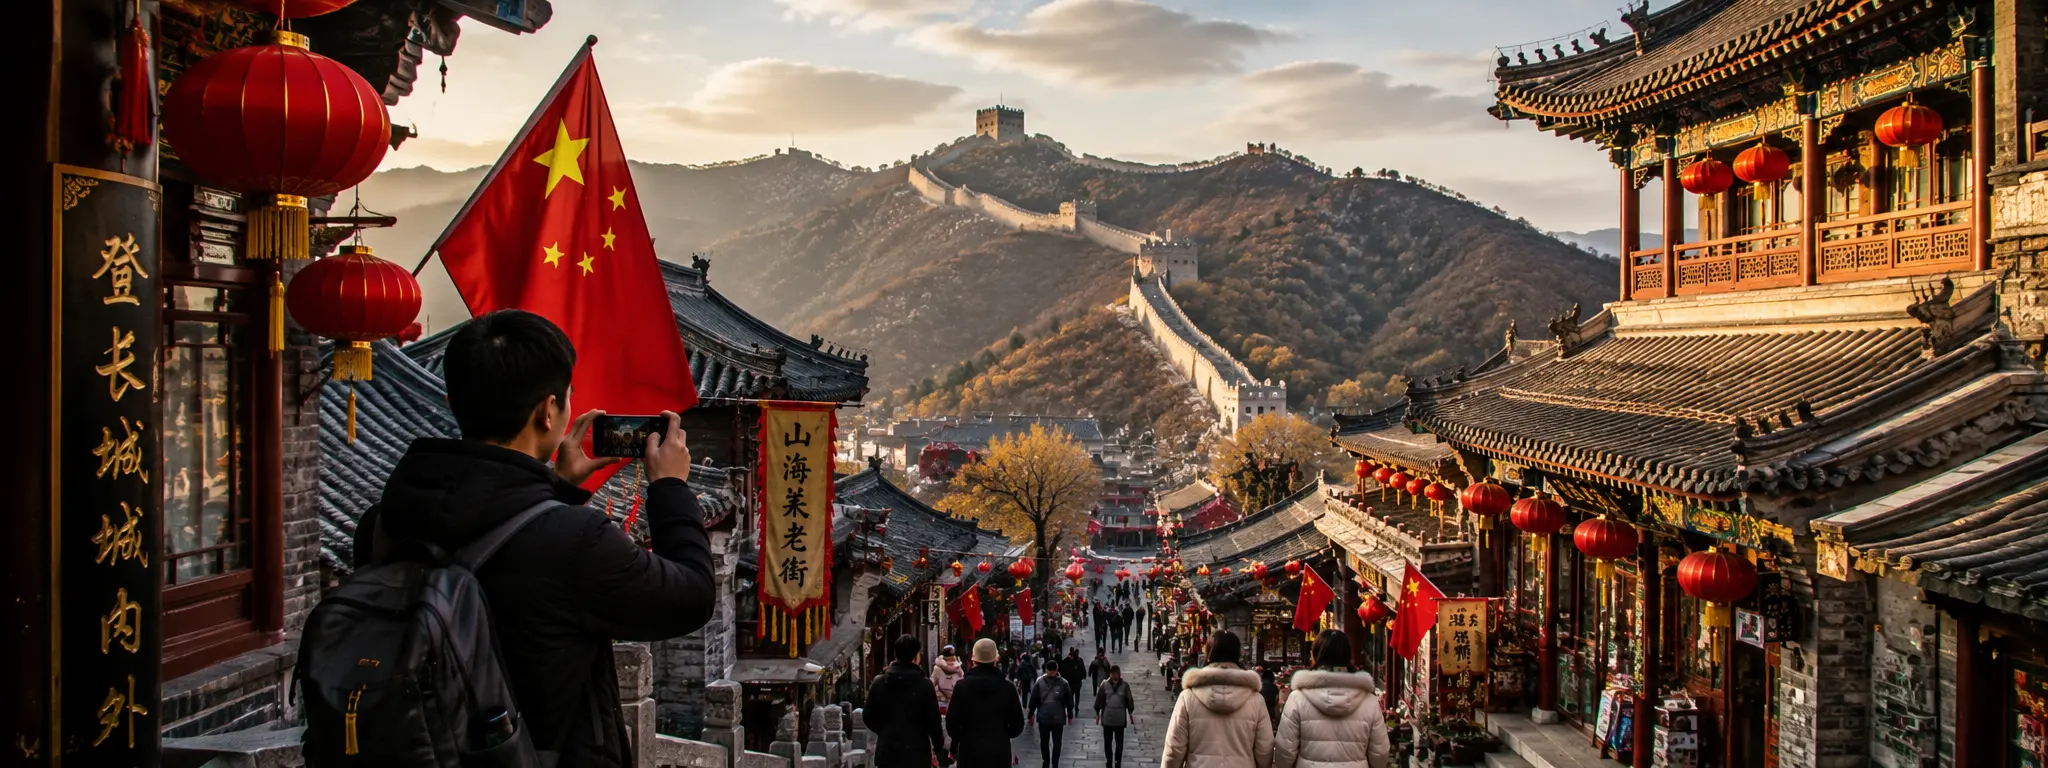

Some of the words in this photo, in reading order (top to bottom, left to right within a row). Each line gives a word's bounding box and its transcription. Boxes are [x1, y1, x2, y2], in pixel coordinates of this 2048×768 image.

[92, 232, 149, 749] 登长城城内外
